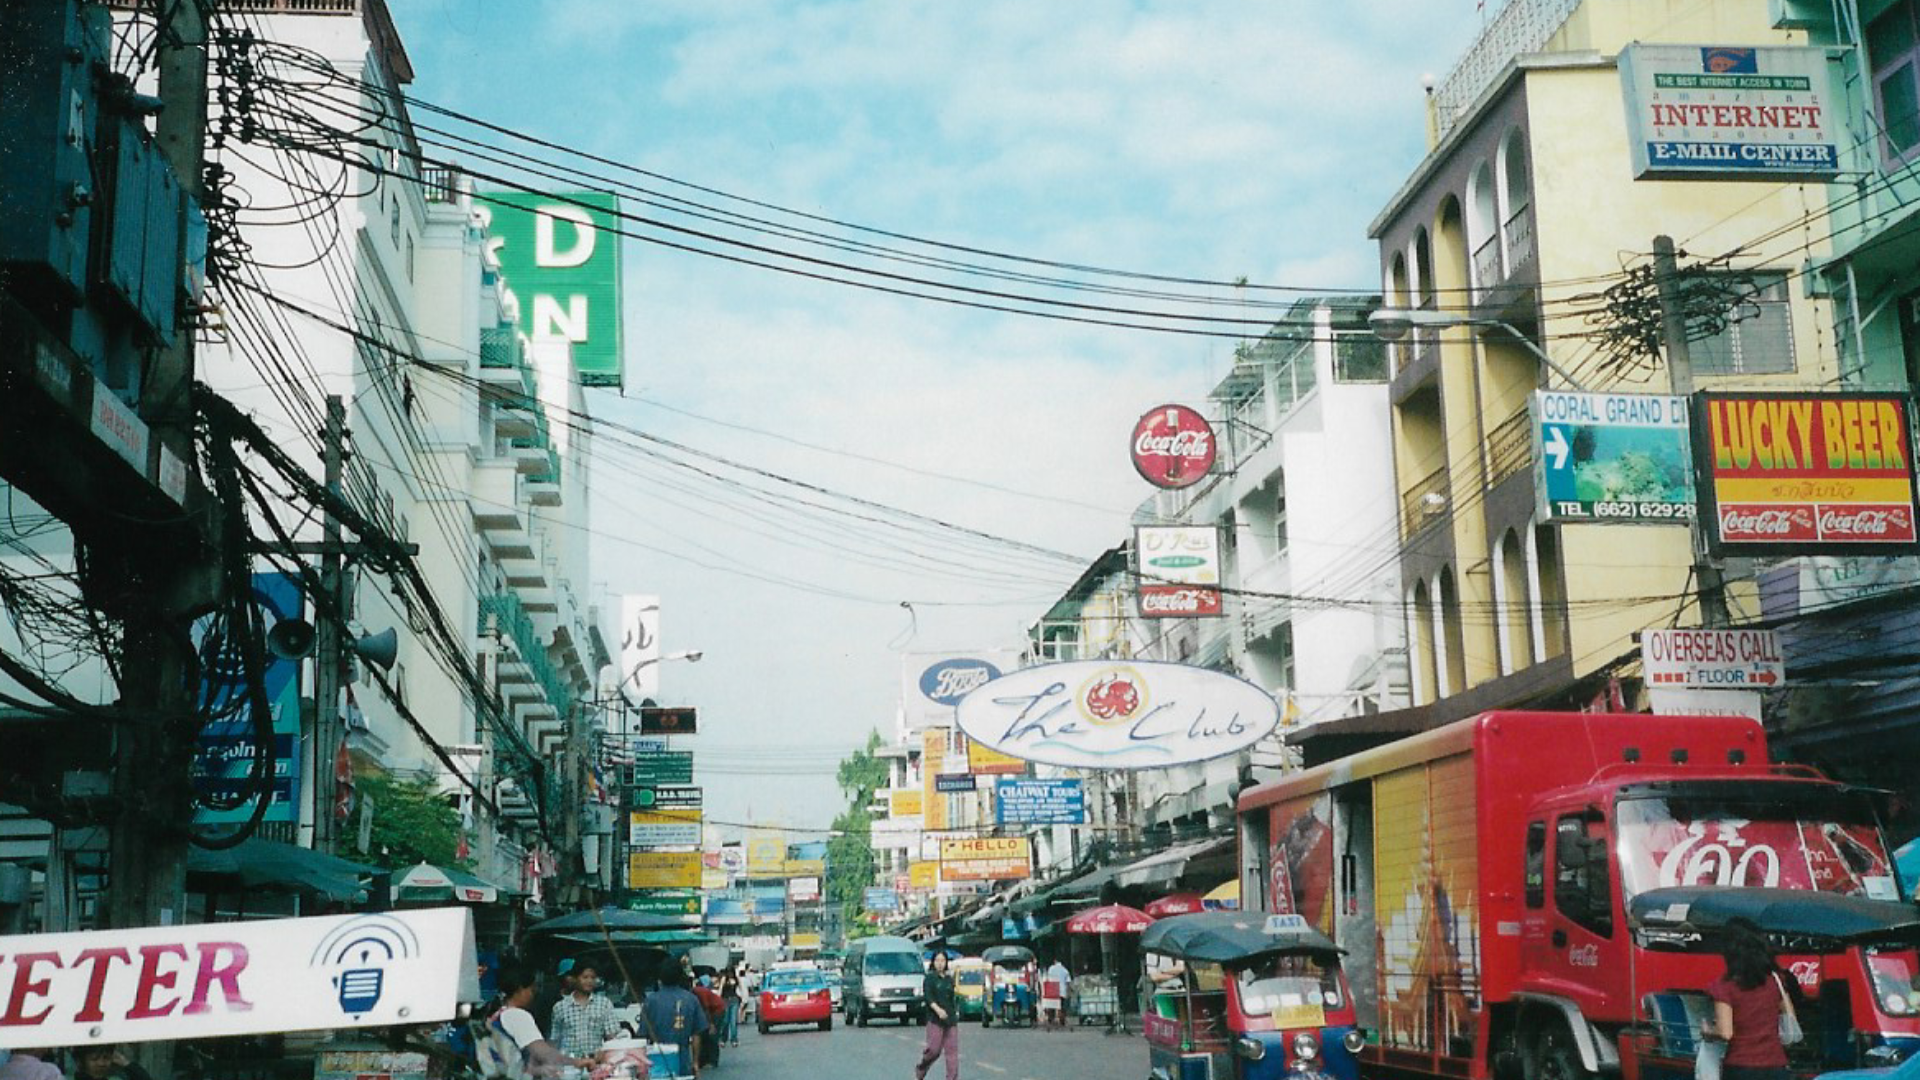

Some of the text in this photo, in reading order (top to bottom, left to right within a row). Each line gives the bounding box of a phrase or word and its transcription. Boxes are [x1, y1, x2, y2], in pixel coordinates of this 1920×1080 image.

[1658, 77, 1808, 89] THE BEST INTERNET ACCESS IN TOWN
[1651, 104, 1822, 129] INTERNET
[1653, 143, 1831, 162] E-MAIL CENTER
[1544, 395, 1599, 421] CORAL
[1605, 397, 1662, 424] GRAND
[1135, 430, 1210, 459] Coca-Cola
[1710, 401, 1906, 470] LUCKY BEER
[1593, 502, 1637, 518] (662)
[1722, 510, 1792, 534] Coca-Cola
[1821, 510, 1888, 534] Coca-Cola
[1651, 632, 1780, 663] OVERSEAS CALL
[930, 667, 989, 697] Boots
[1697, 669, 1745, 684] FLOOR
[992, 682, 1256, 744] The Club
[962, 840, 1018, 851] HELLO
[1272, 916, 1301, 928] TAXI
[0, 940, 254, 1027] ETER
